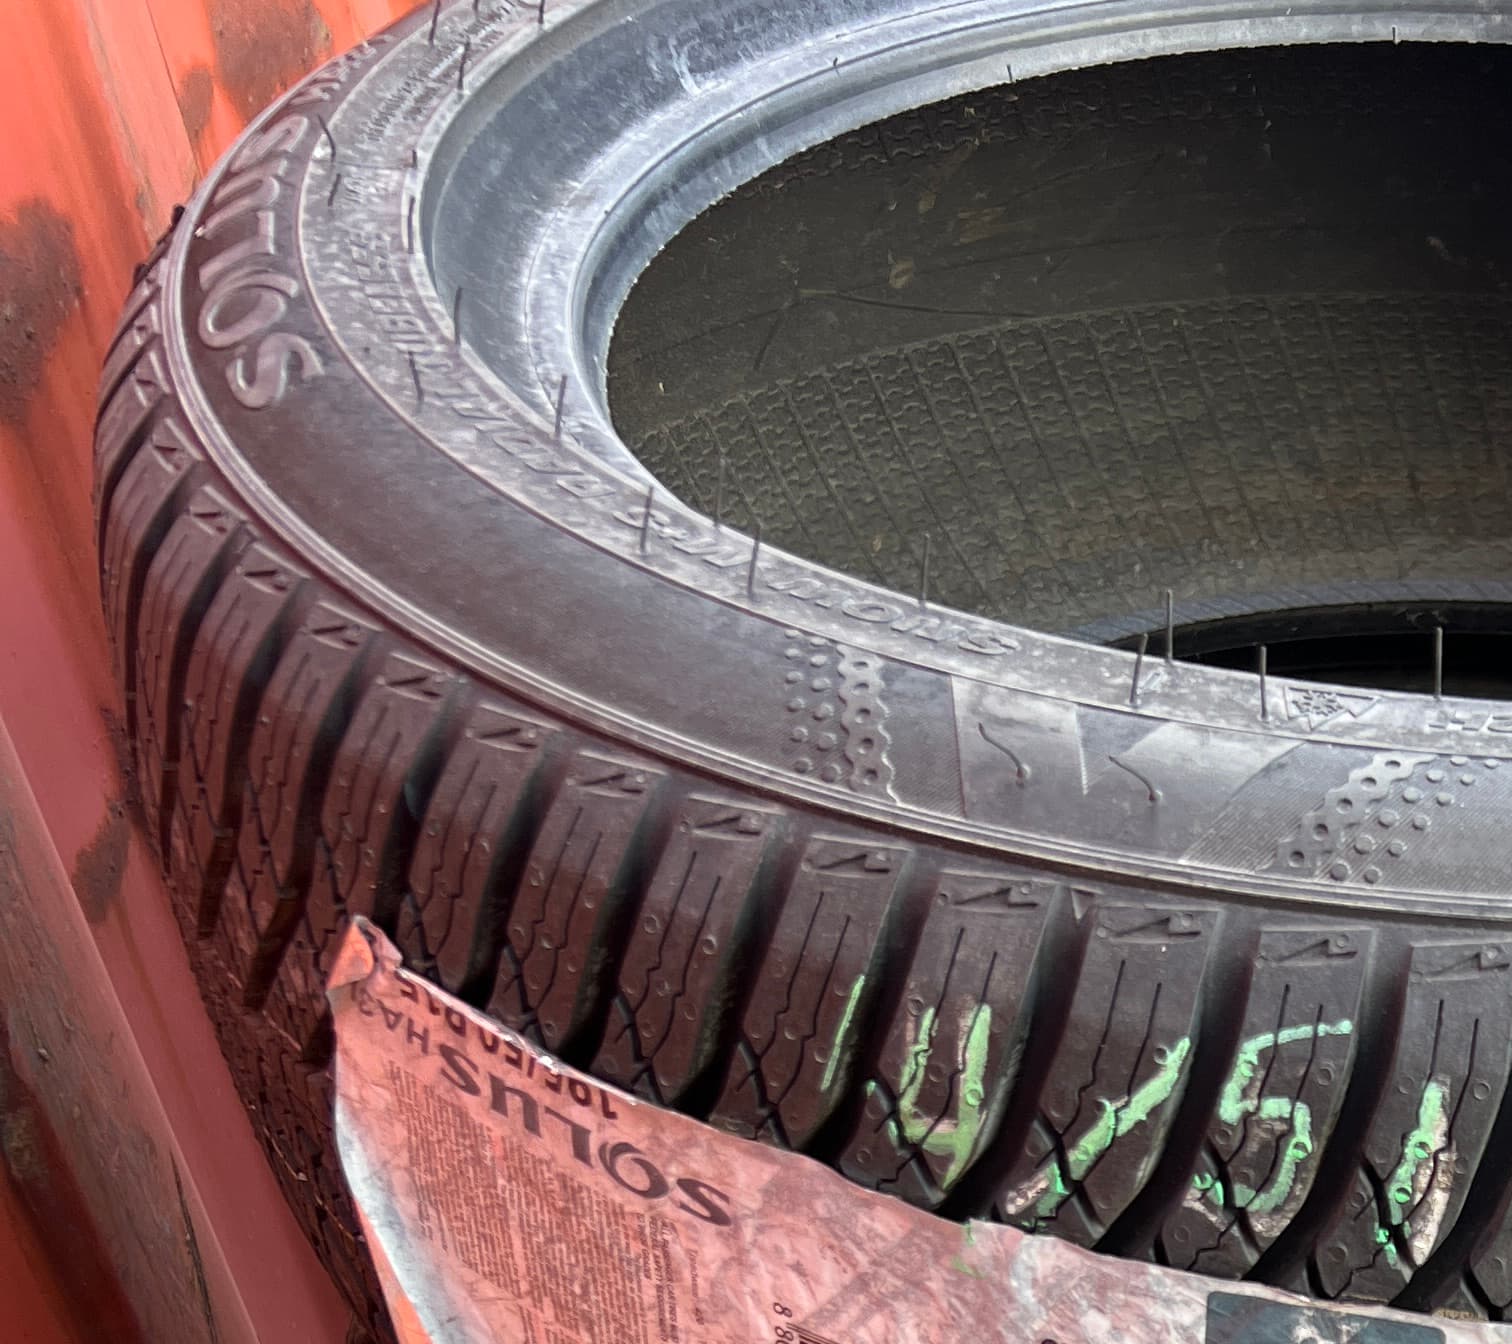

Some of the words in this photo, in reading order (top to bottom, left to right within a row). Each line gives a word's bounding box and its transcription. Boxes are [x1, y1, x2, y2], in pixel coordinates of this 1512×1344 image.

[193, 113, 325, 409] SOLUS
[358, 984, 431, 1057] HA3
[435, 1046, 732, 1229] SOLUS
